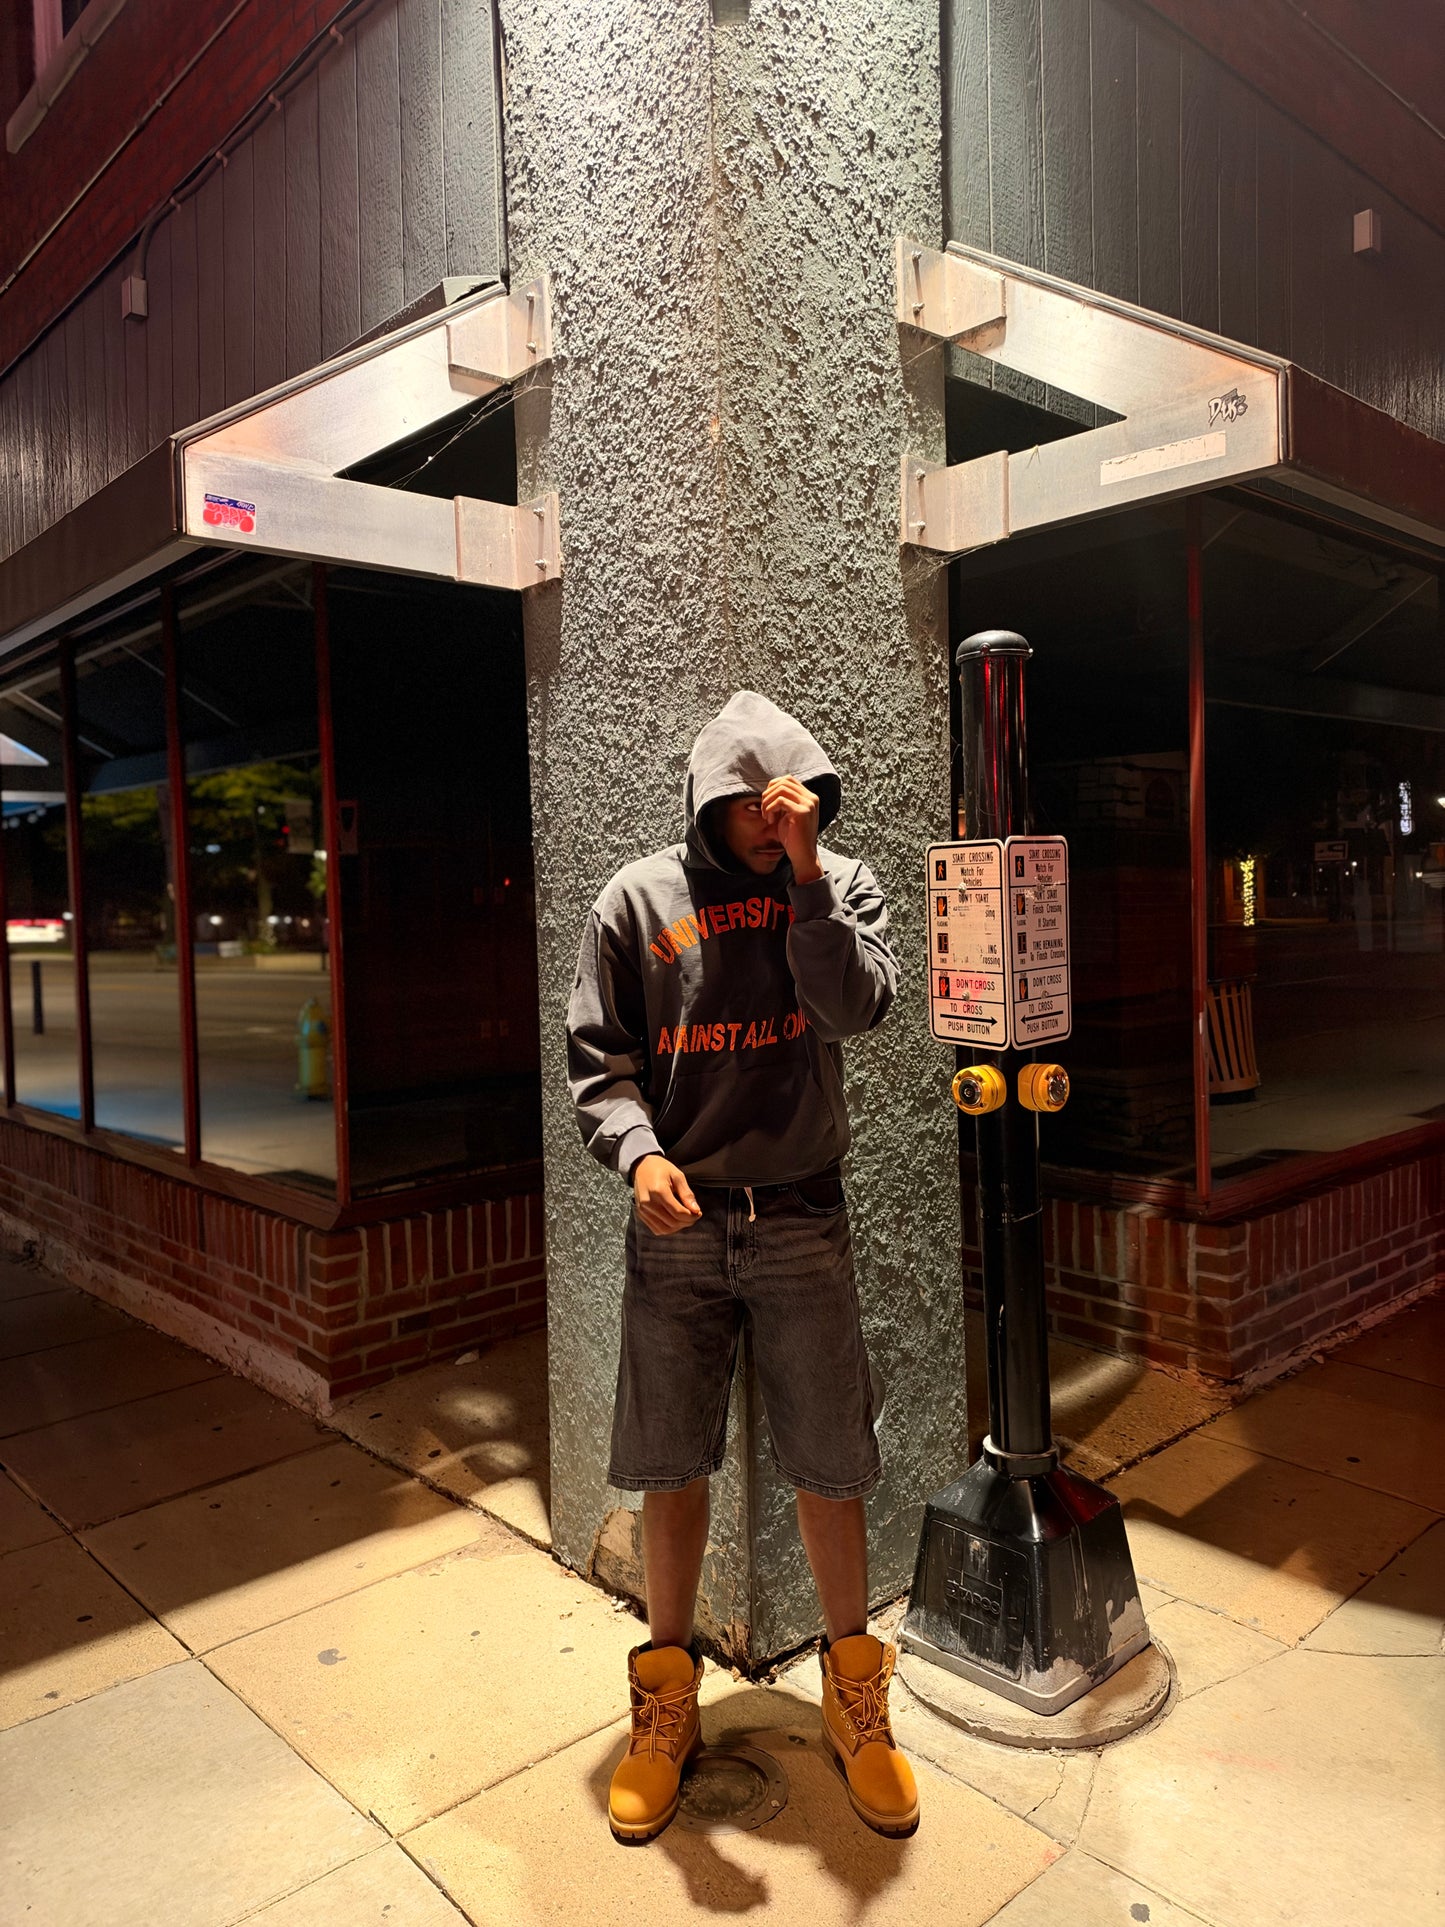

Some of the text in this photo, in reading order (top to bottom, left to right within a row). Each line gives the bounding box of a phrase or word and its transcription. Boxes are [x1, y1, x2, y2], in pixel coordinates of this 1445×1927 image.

[952, 851, 994, 863] START CROSSING
[1029, 849, 1061, 859] START CROSSING
[960, 866, 984, 877] Watch For
[975, 893, 989, 903] START
[981, 955, 1000, 968] rossing
[956, 978, 996, 991] DON'T CROSS
[1046, 973, 1062, 986] CROSS
[950, 1002, 983, 1016] TO CROSS
[1028, 1000, 1054, 1014] TO CROSS
[657, 1008, 811, 1055] AAINST ALL ON
[947, 1020, 991, 1035] PUSH BUTTON
[1026, 1017, 1059, 1034] PUSH BUTTON
